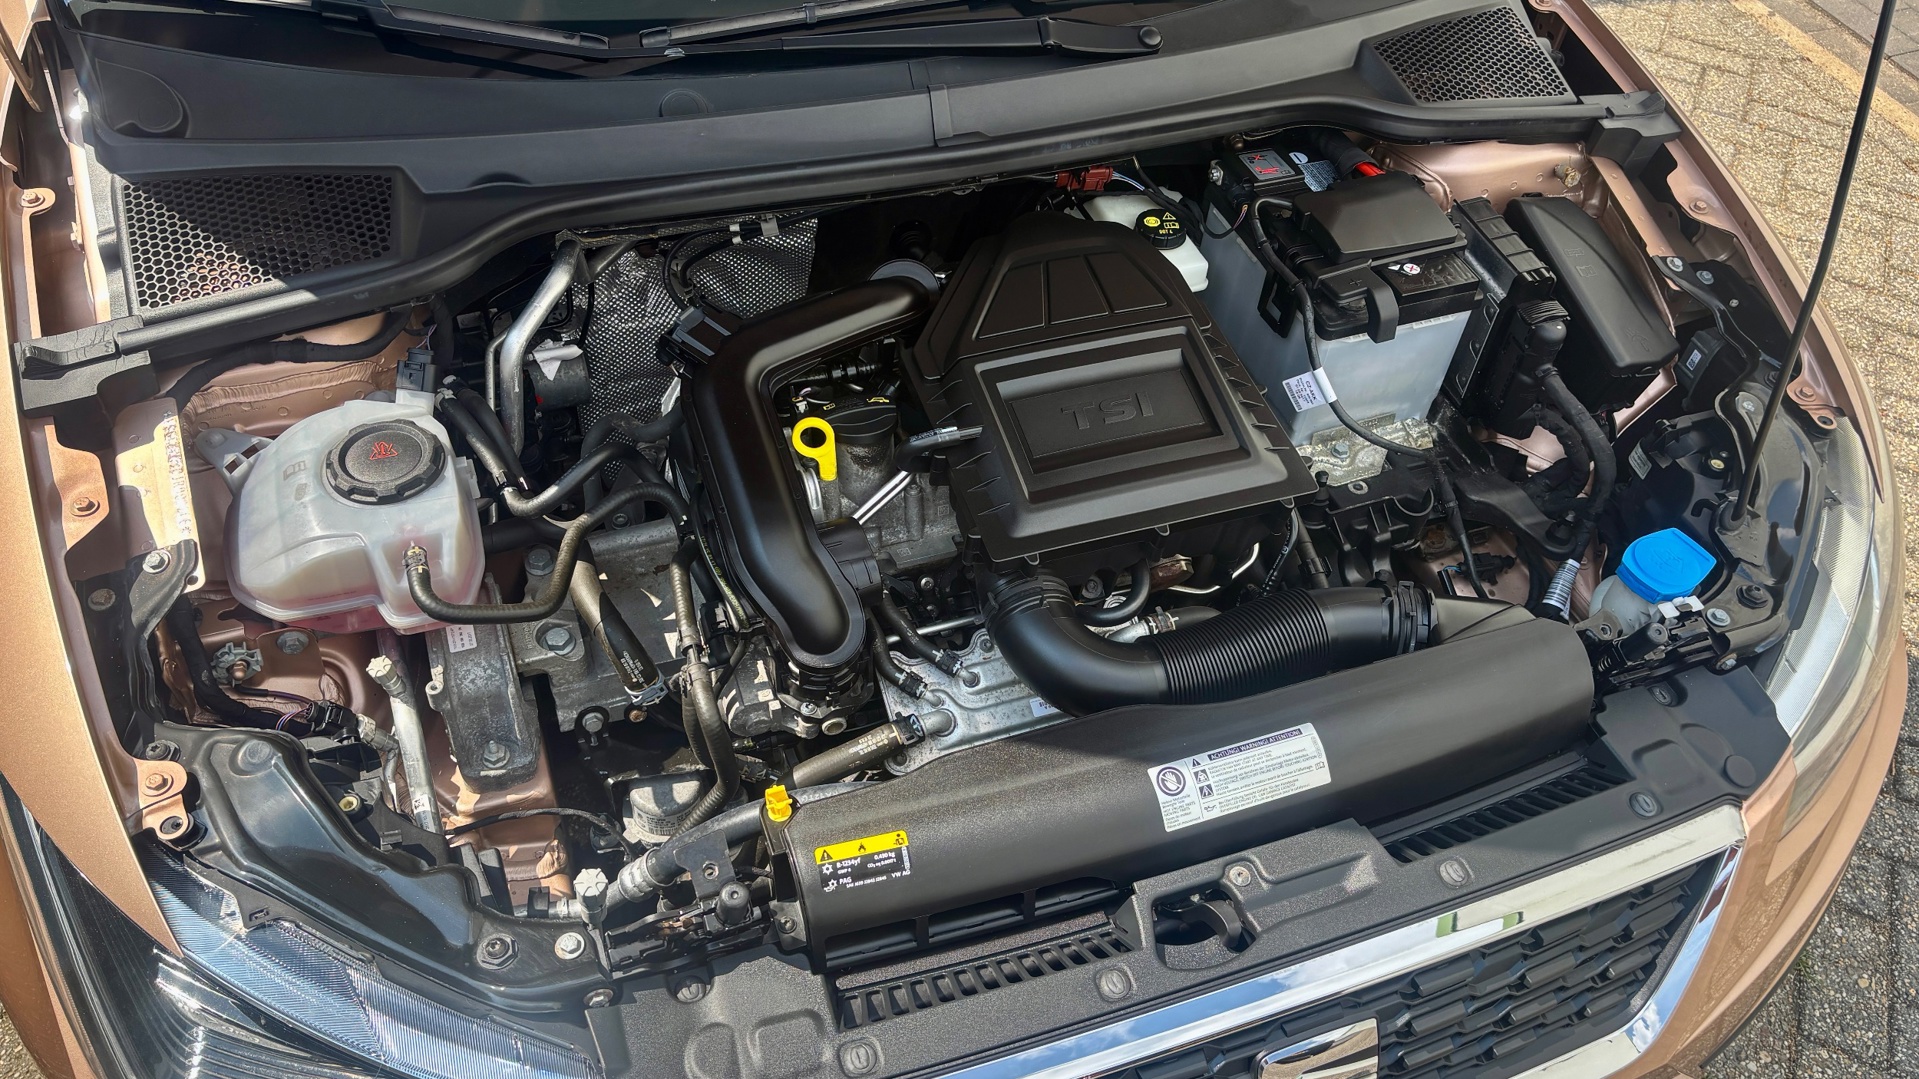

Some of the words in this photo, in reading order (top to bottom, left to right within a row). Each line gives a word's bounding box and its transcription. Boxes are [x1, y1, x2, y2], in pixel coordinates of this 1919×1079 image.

[1061, 391, 1154, 429] TSI
[1211, 747, 1239, 760] ACHTUNG!
[1240, 739, 1268, 751] WARNING!
[1269, 730, 1300, 743] ATTENTION!
[839, 876, 852, 885] PAG
[891, 870, 902, 878] VW
[902, 869, 911, 877] AG
